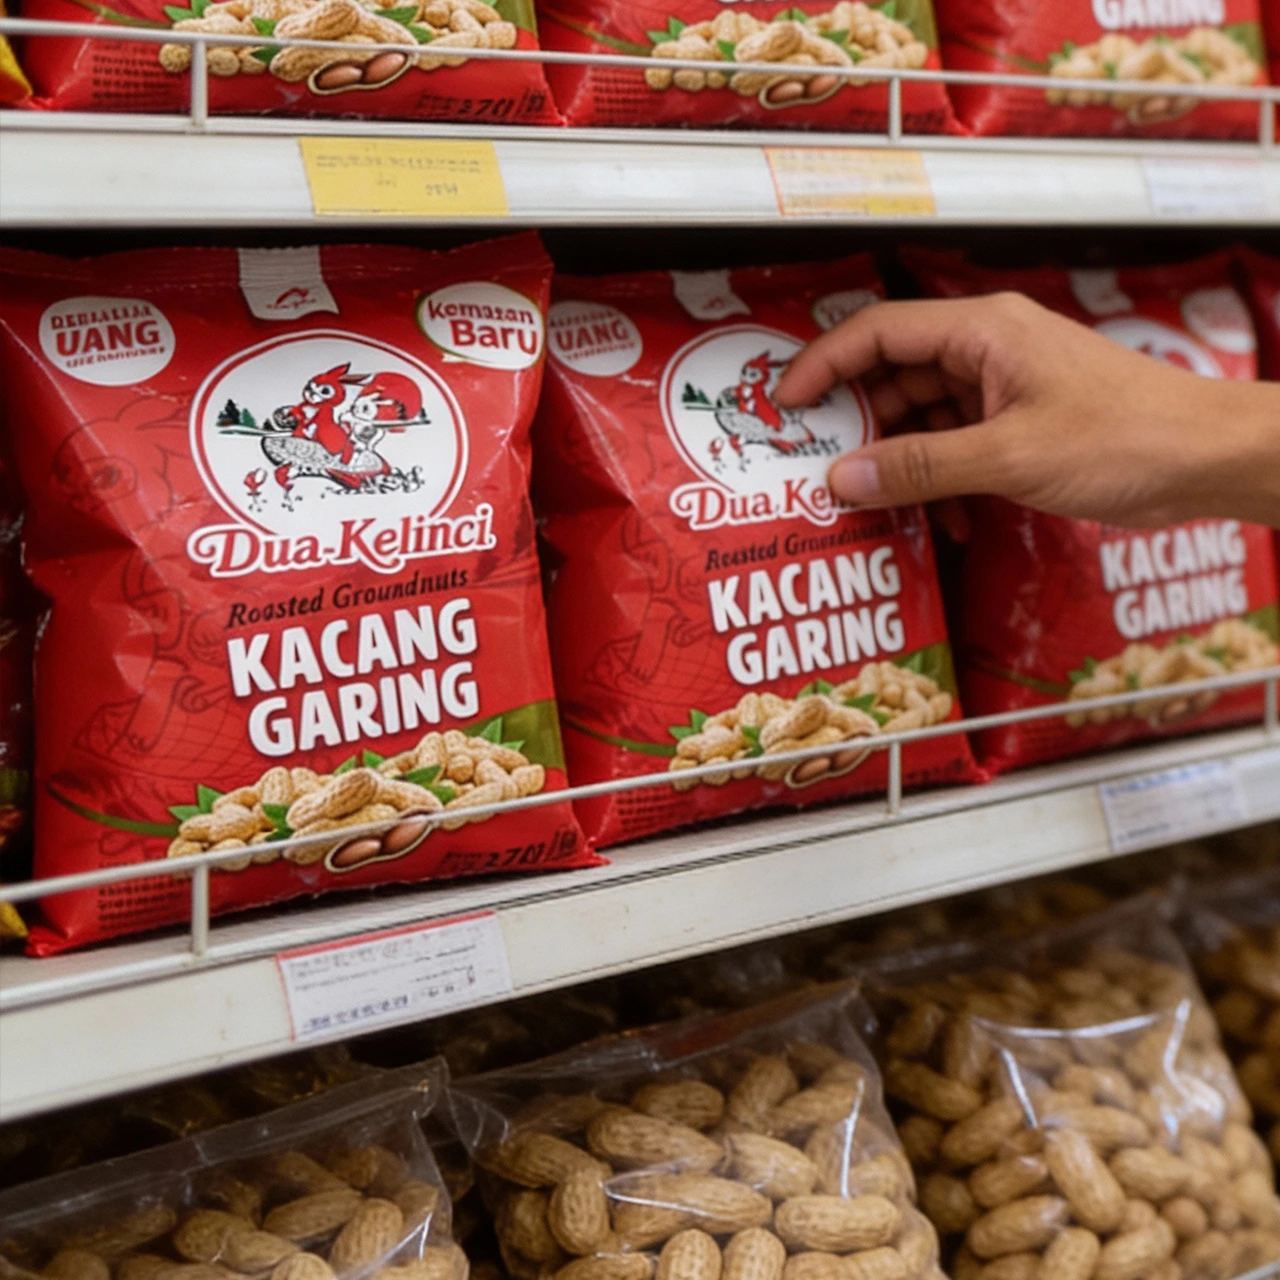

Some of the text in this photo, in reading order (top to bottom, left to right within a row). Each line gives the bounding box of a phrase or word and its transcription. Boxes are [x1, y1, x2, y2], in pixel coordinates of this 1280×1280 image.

[56, 320, 160, 357] UANG
[449, 319, 537, 356] Baru
[556, 319, 629, 352] UANG
[191, 504, 495, 573] Dua-Kelinci
[1101, 520, 1246, 592] KACANG
[226, 568, 468, 629] Roasted Groundnuts
[707, 545, 901, 634] KACANG
[1113, 568, 1248, 640] GARING
[227, 598, 478, 698] KACANG
[726, 601, 905, 685] GARING
[249, 661, 479, 758] GARING
